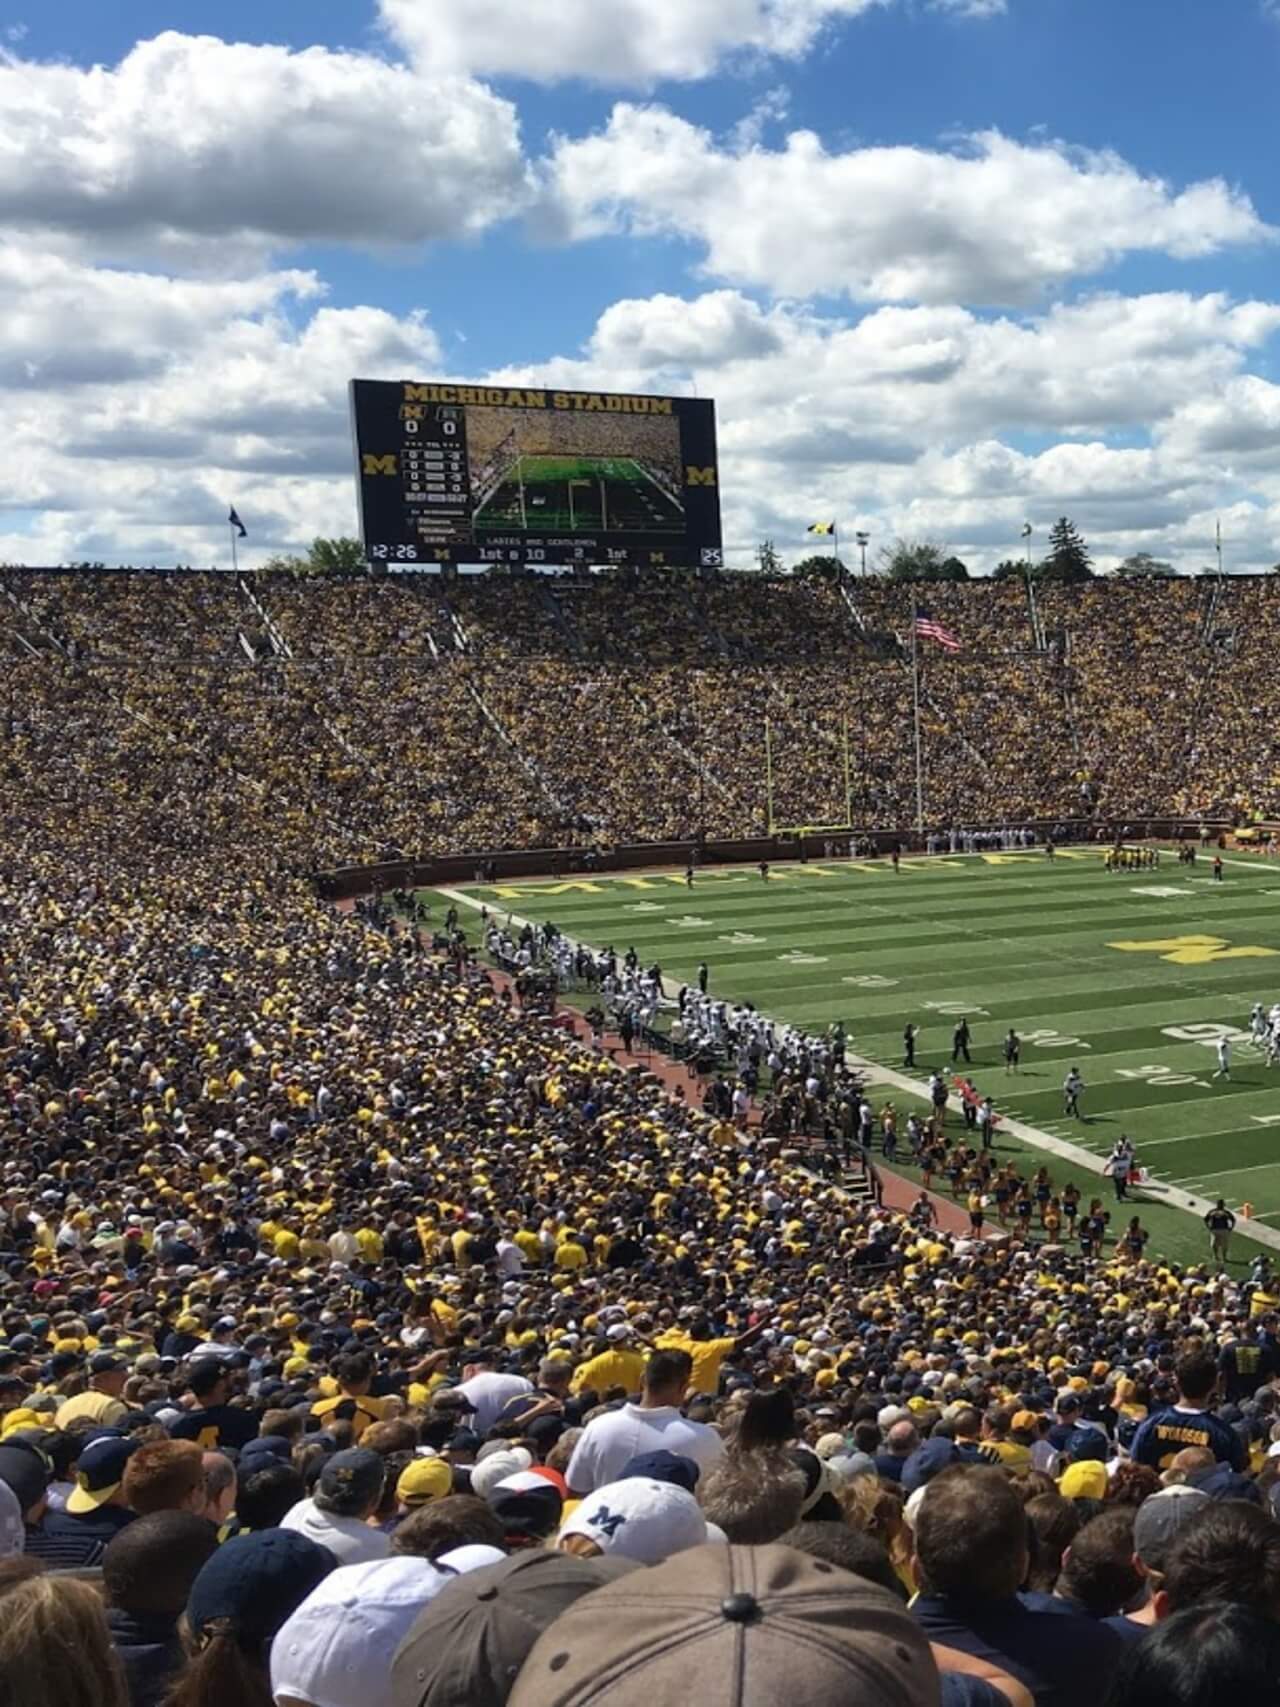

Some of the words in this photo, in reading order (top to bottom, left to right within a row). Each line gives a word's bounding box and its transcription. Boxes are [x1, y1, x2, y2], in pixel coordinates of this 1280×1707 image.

[403, 384, 546, 409] MICHIGAN
[553, 393, 673, 414] STADIUM
[405, 420, 418, 433] 0
[443, 422, 456, 435] 0
[362, 454, 397, 475] M
[687, 466, 716, 486] M
[480, 548, 502, 559] 1st
[527, 549, 545, 561] 10
[703, 549, 721, 563] 25
[1114, 1064, 1197, 1087] 20
[586, 1505, 626, 1537] M
